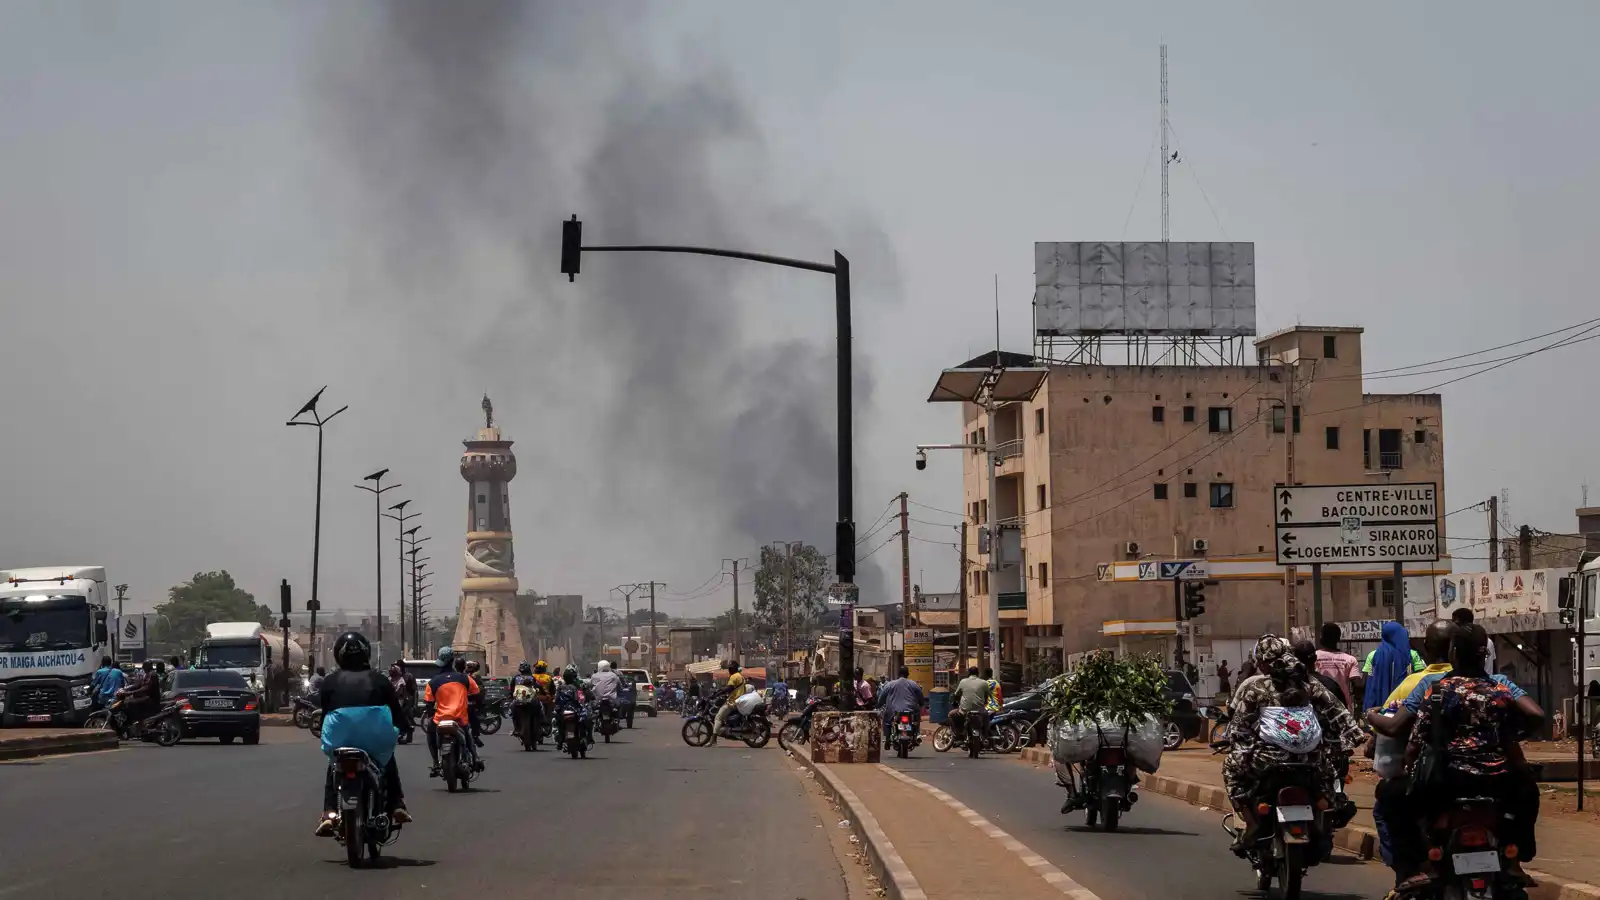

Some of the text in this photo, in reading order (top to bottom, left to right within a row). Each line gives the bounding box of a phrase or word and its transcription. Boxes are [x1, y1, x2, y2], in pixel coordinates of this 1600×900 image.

[1337, 490, 1433, 502] CENTRE-VILLE
[1322, 505, 1433, 517] BACODJICORONI
[1369, 530, 1434, 541] SIRAKORO
[1298, 544, 1435, 558] LOGEMENTS SOCIAUX
[10, 656, 36, 668] MAIGA
[37, 653, 77, 667] AICHATOU
